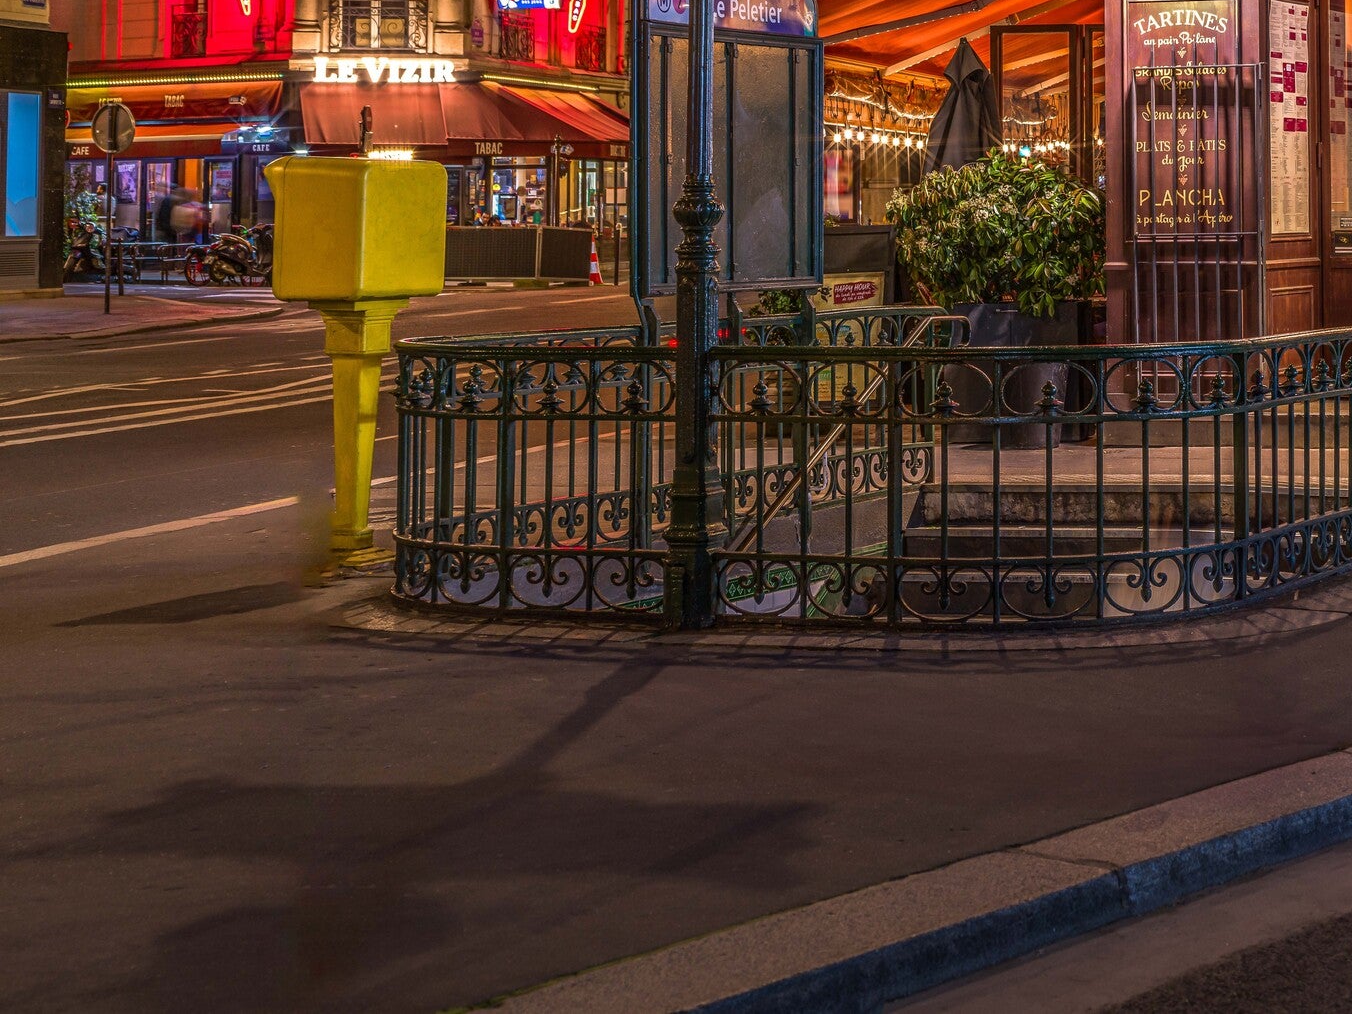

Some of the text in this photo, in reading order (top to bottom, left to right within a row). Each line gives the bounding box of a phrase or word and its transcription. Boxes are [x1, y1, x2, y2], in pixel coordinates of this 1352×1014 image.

[1134, 9, 1228, 36] TARTINES
[1158, 36, 1179, 48] pain
[313, 56, 457, 83] LE VIZIR
[164, 94, 185, 108] TABAC
[252, 144, 270, 152] CAFE
[475, 142, 503, 155] TABAC
[1176, 140, 1186, 152] &
[1162, 154, 1174, 165] du
[1184, 214, 1192, 224] à
[834, 282, 871, 294] HAPPY HOUR
